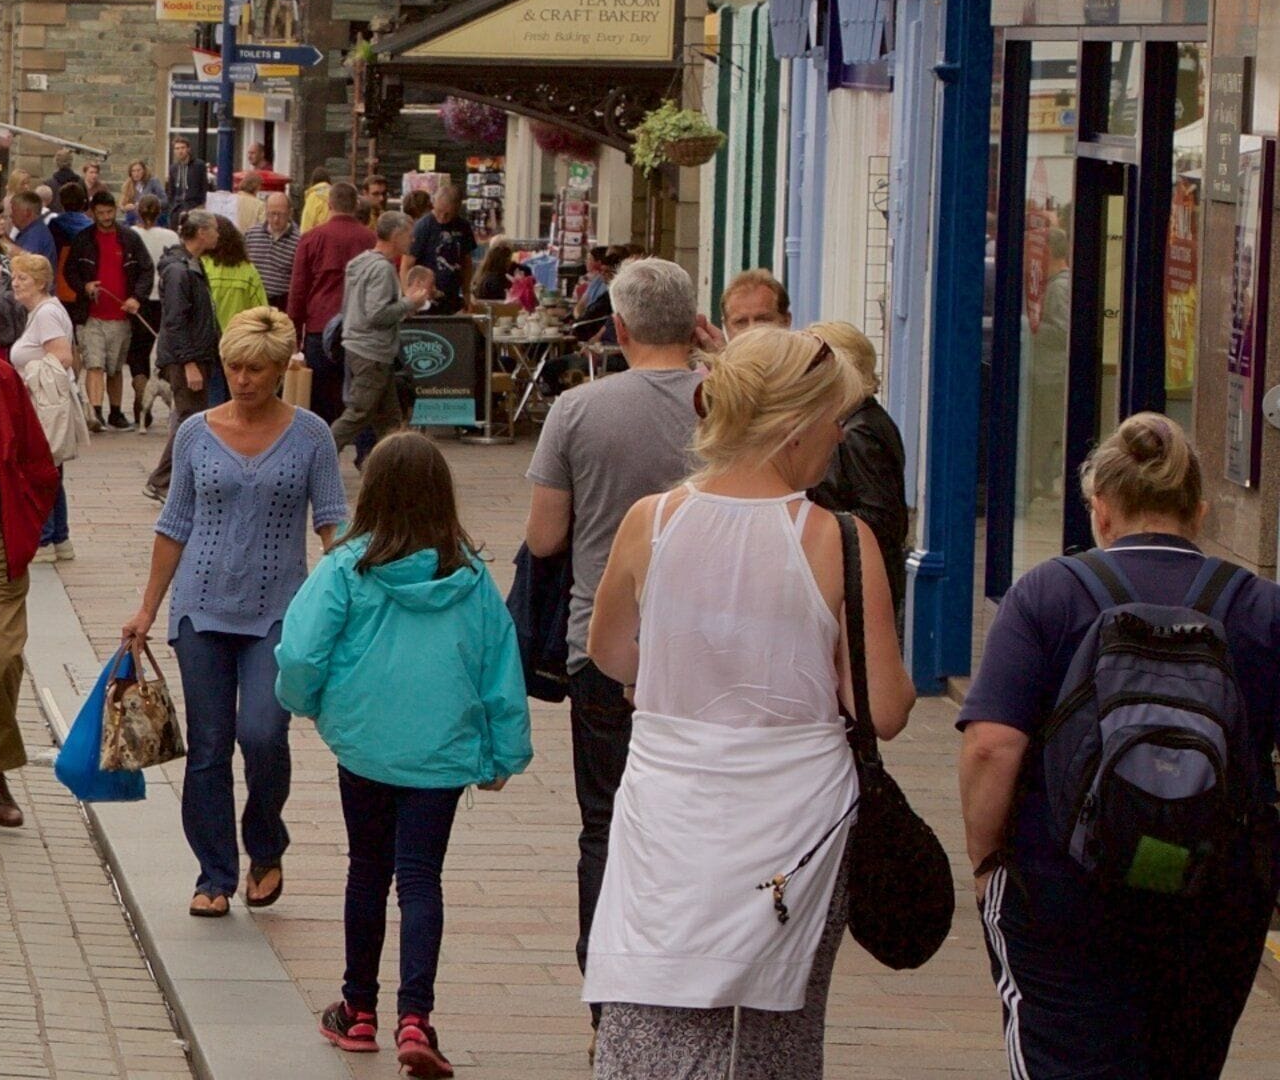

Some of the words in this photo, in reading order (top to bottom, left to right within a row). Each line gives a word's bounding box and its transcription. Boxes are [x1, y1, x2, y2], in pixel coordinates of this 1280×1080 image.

[164, 1, 193, 11] Kodak
[195, 1, 224, 12] Expre
[523, 9, 535, 21] &
[540, 9, 592, 21] CRAFT
[599, 10, 659, 22] BAKERY
[523, 31, 550, 41] Fresh
[555, 32, 590, 44] Baking
[596, 32, 625, 44] Every
[630, 33, 651, 45] Day
[240, 49, 272, 59] TOILETS
[415, 386, 471, 395] Confectioners
